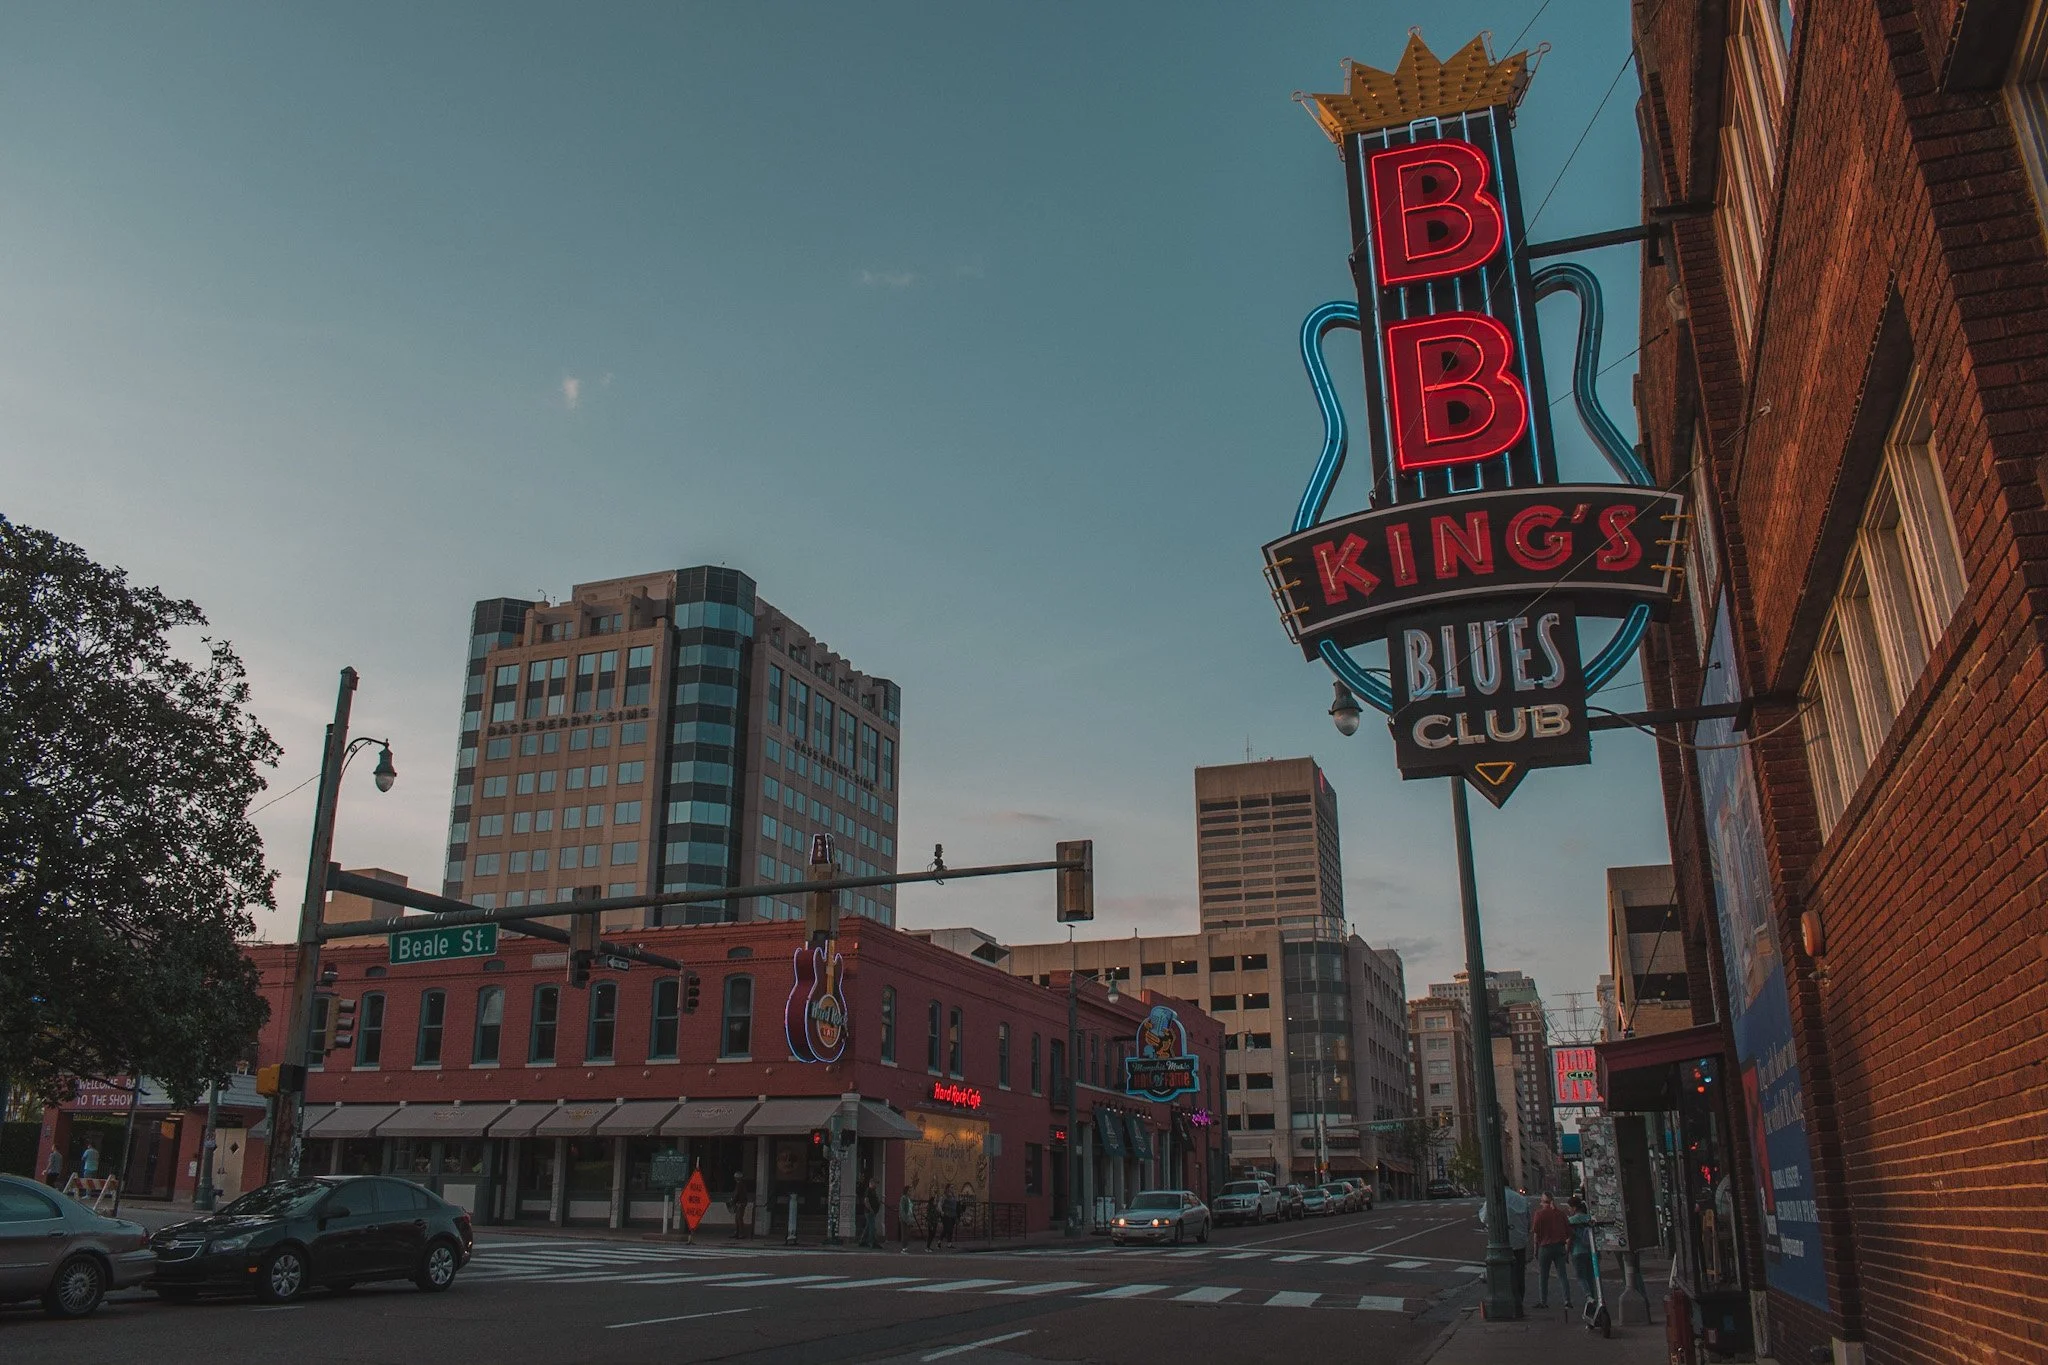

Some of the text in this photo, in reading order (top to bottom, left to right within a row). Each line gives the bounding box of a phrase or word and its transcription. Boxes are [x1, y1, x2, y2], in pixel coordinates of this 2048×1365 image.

[1367, 137, 1504, 286] B
[1382, 311, 1528, 471] B
[1312, 503, 1643, 606] KING'S
[1403, 612, 1566, 702] BLUES
[487, 723, 530, 737] BASS
[536, 714, 593, 731] BERRY
[606, 707, 650, 723] SIMS
[1412, 703, 1572, 750] CLUB
[398, 929, 489, 960] Beale St.
[811, 1000, 831, 1022] Hard
[1166, 1060, 1190, 1071] Music
[1556, 1048, 1597, 1071] BLUE
[76, 1094, 88, 1106] TO
[91, 1094, 107, 1106] THE
[934, 1081, 983, 1109] Hard Rock Cafe
